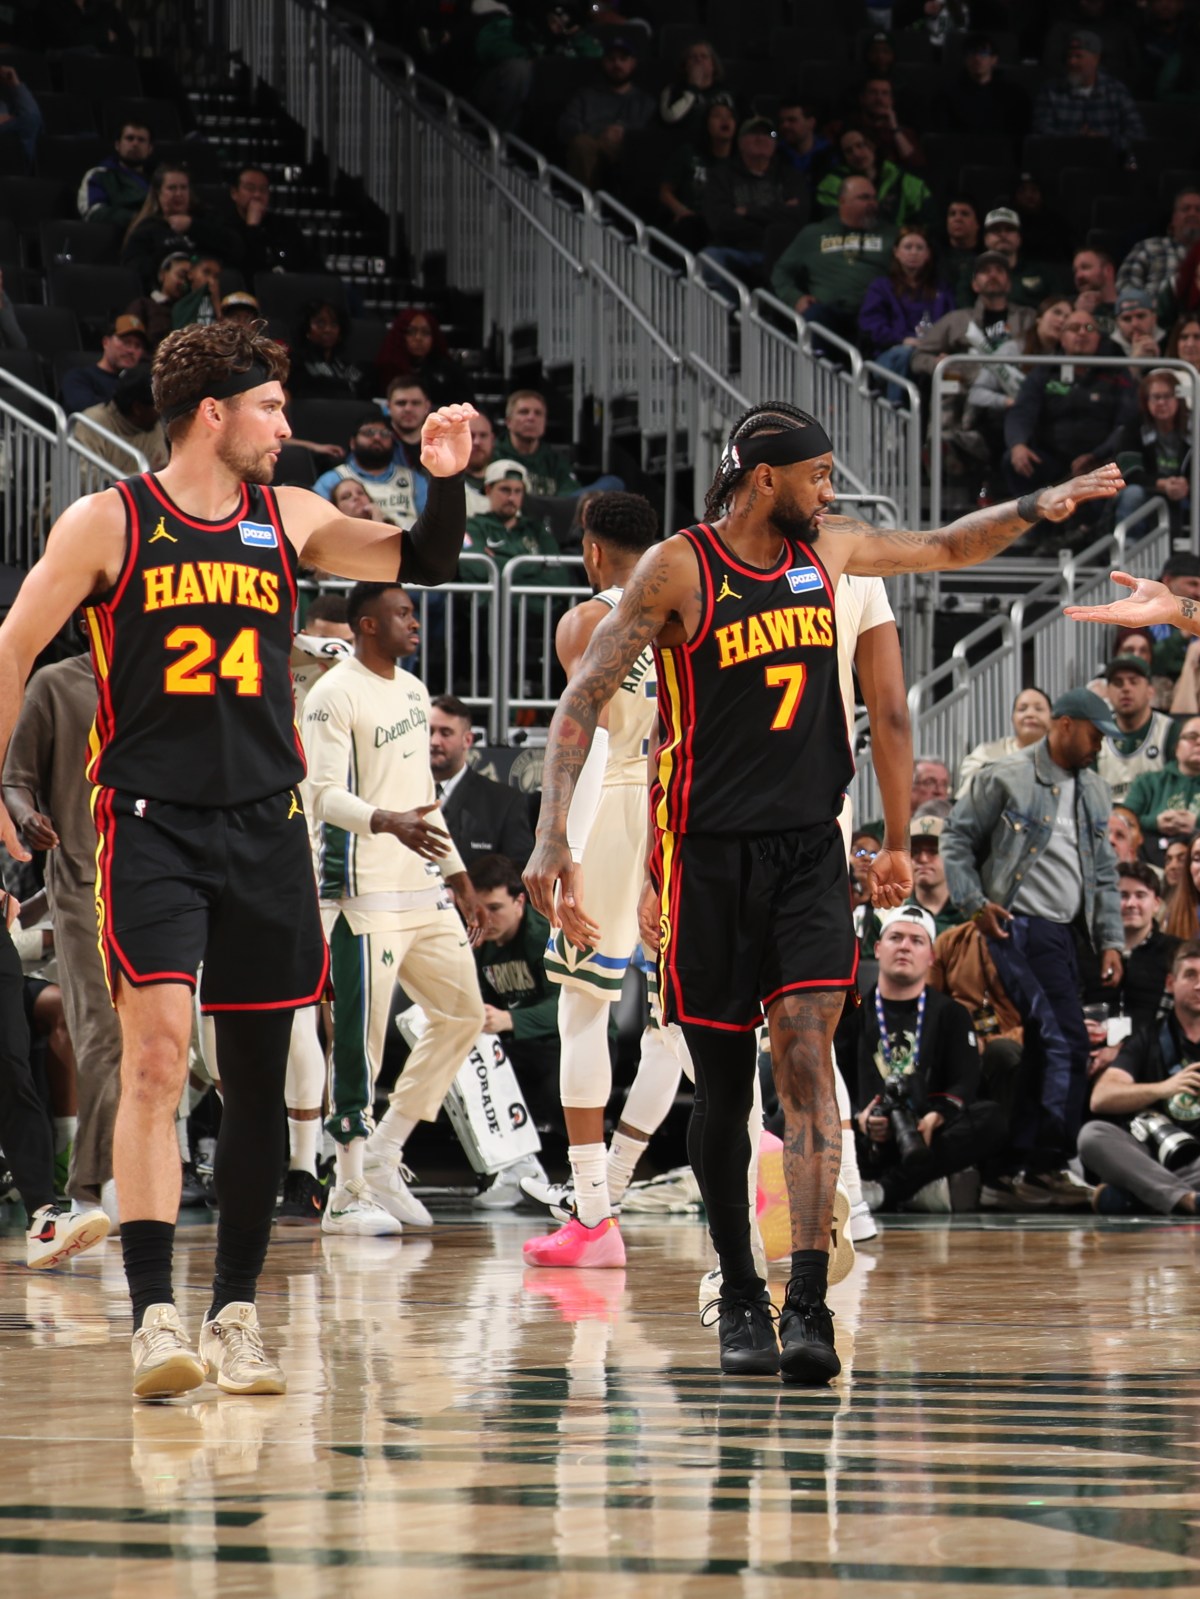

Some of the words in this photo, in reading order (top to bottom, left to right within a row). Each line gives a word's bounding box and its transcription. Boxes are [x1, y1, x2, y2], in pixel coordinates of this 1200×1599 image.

[243, 526, 272, 541] paze
[142, 560, 280, 614] HAWKS
[790, 571, 818, 587] paze
[163, 624, 263, 697] 24
[714, 605, 835, 669] HAWKS
[306, 709, 330, 723] wilo
[764, 661, 808, 731] 7
[374, 718, 412, 749] Cream
[409, 707, 427, 732] City
[468, 1045, 501, 1135] TORADE
